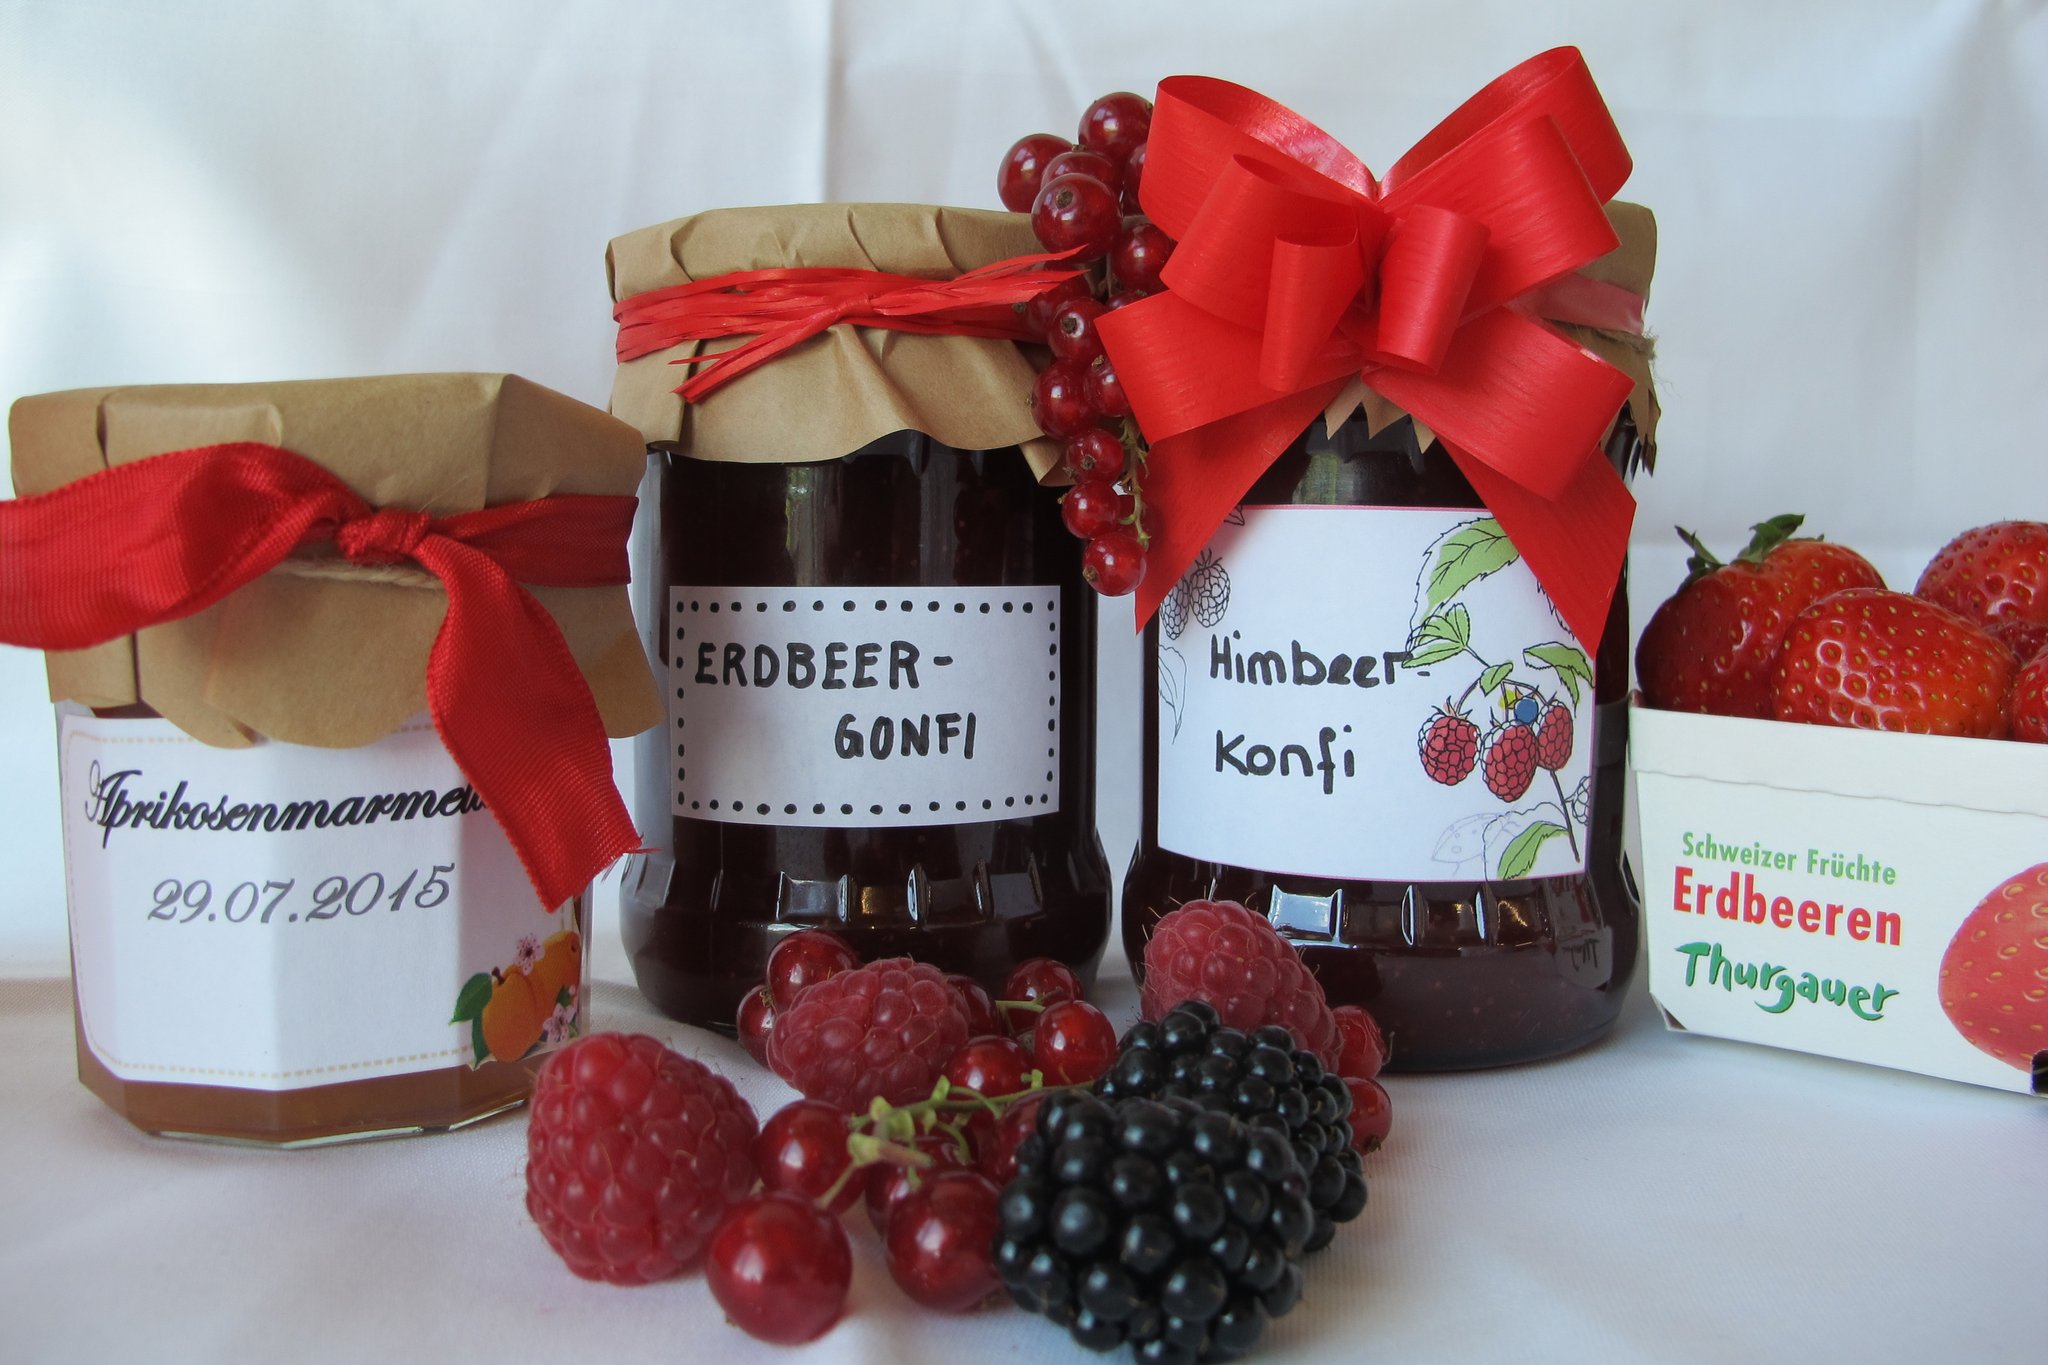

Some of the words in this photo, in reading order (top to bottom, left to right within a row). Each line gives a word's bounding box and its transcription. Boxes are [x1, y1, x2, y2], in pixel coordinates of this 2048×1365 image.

[695, 641, 953, 689] ERDBEER-
[1210, 630, 1430, 688] Himbeer-
[1215, 725, 1355, 795] Konfi
[1682, 832, 1797, 870] Schweizer
[1806, 848, 1896, 886] Früchte
[147, 863, 455, 923] 29.07.2015
[1673, 865, 1902, 946] Erdbeeren
[1674, 942, 1899, 1021] Thurgauer
